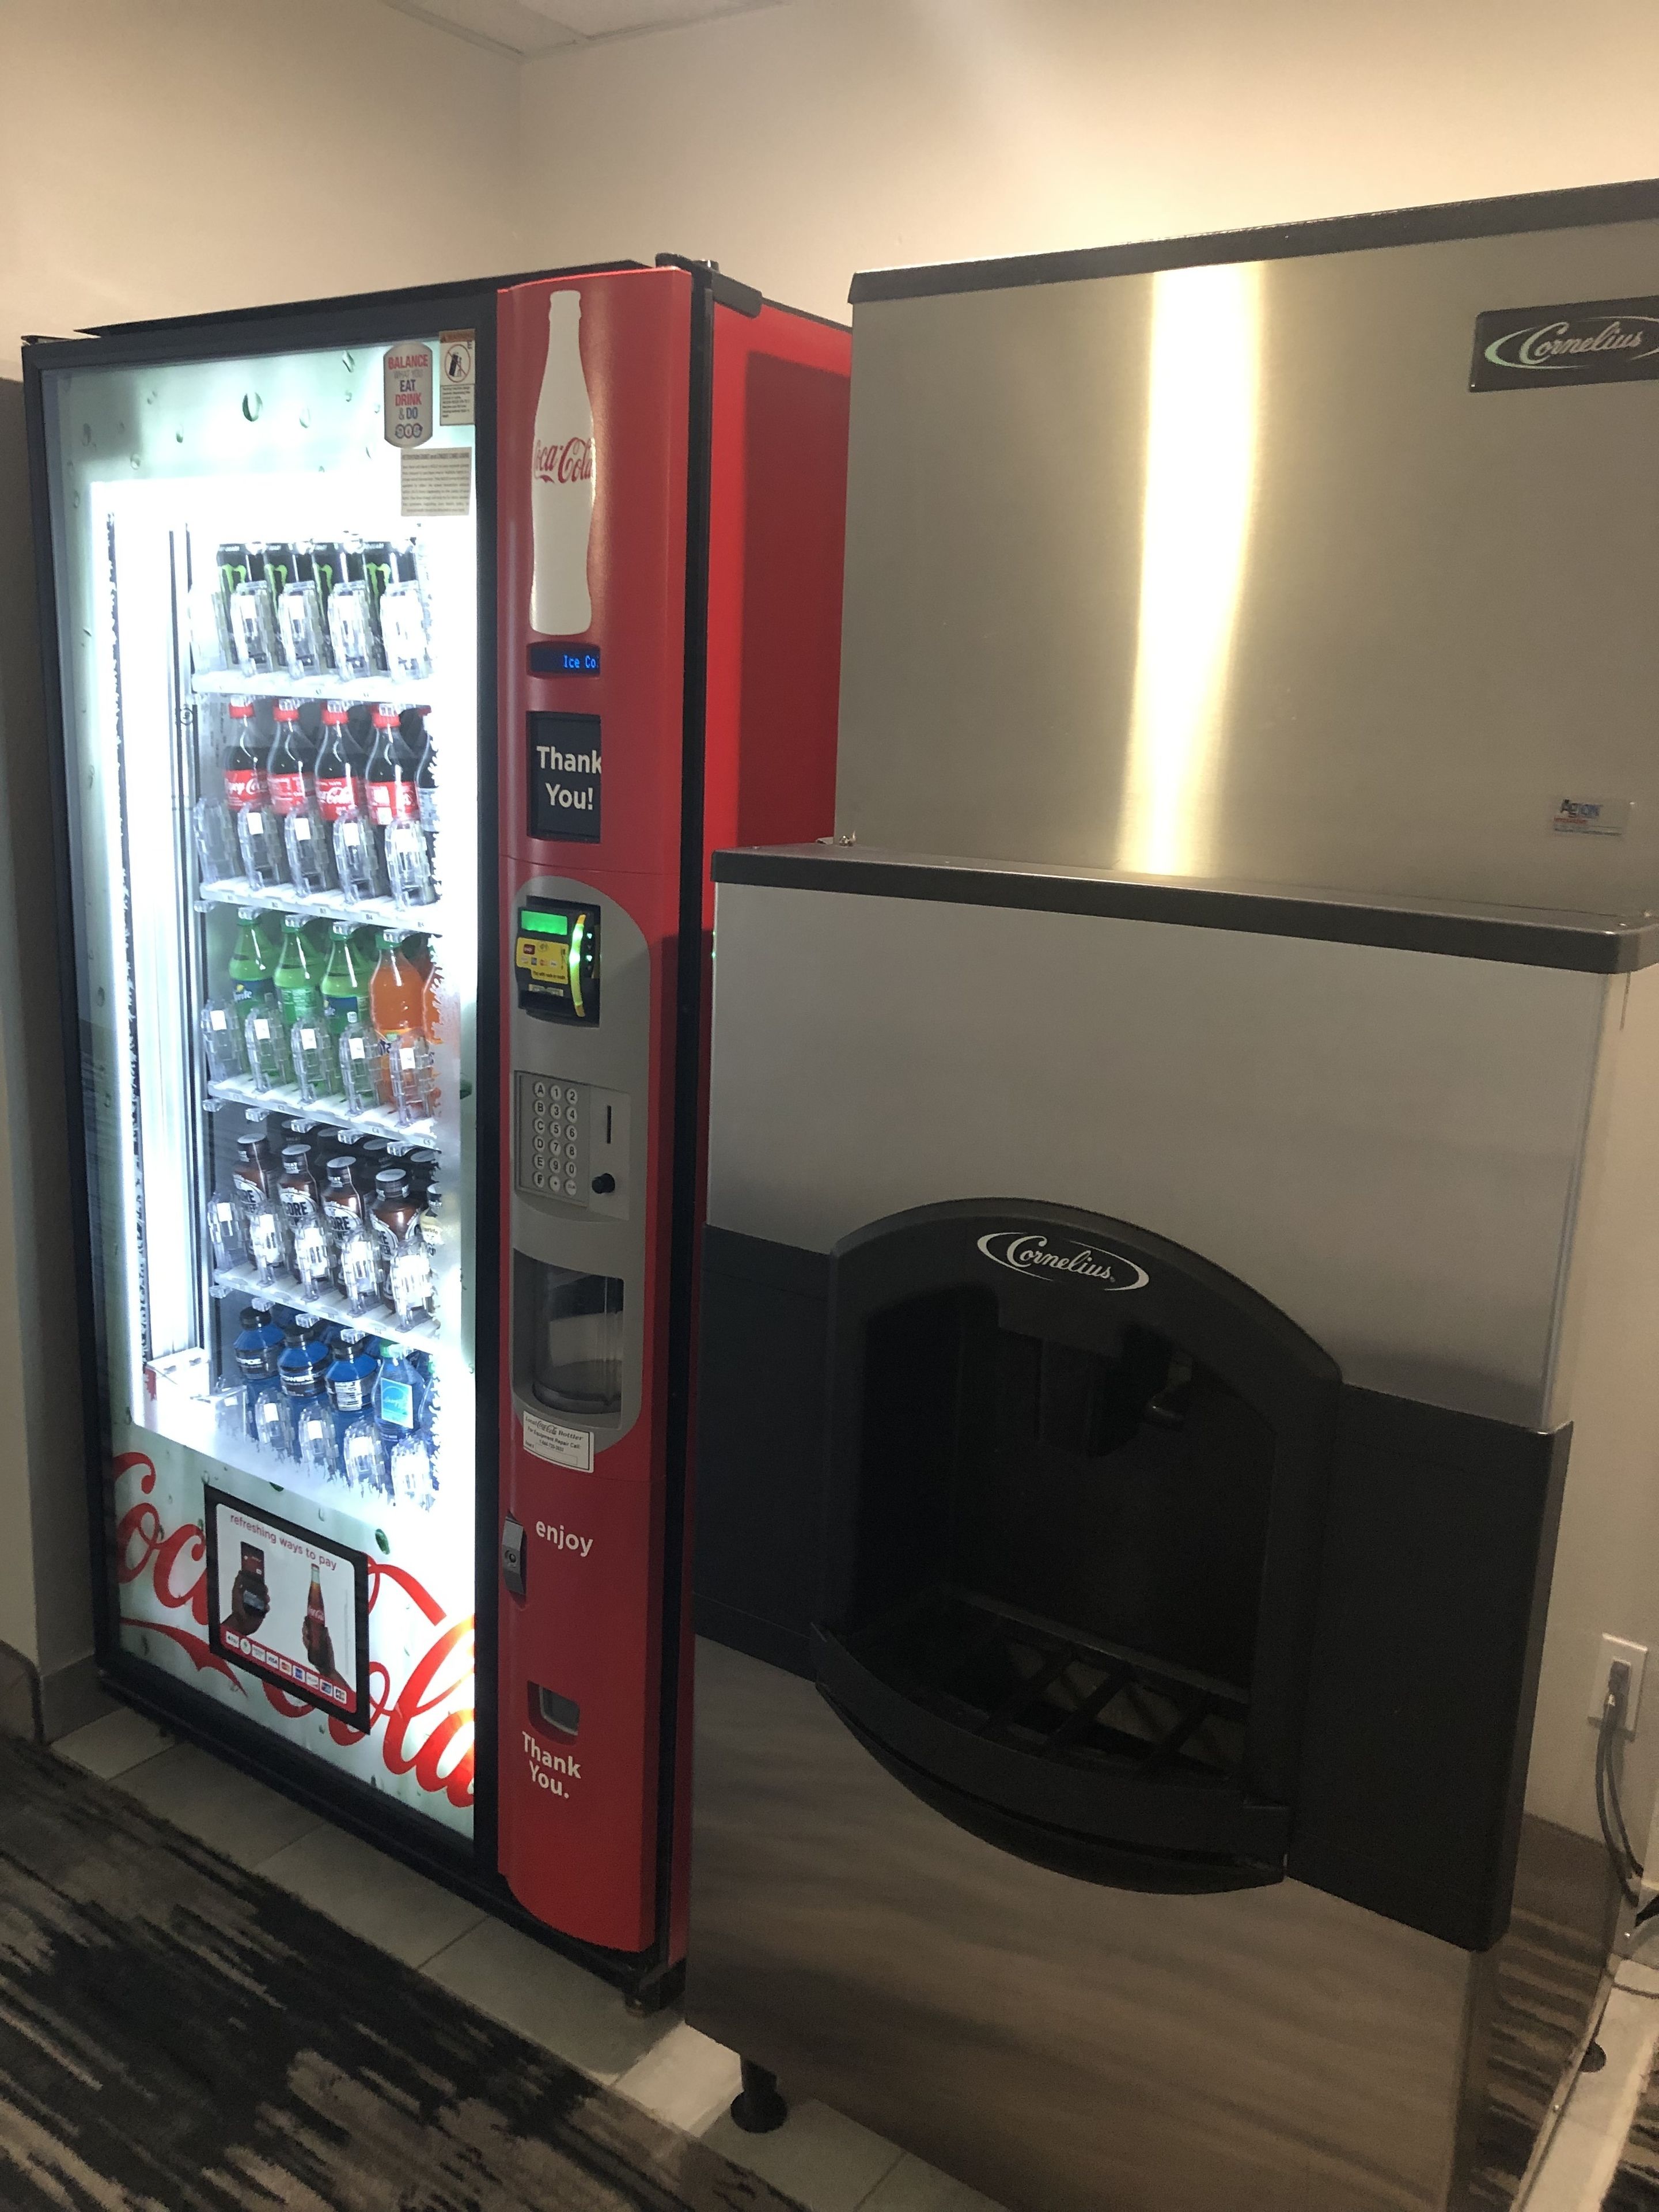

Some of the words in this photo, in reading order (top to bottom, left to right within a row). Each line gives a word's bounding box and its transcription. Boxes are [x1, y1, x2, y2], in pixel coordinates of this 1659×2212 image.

[1519, 320, 1643, 365] Cornelius
[388, 354, 428, 370] BALANCE
[400, 380, 415, 392] EAT
[395, 393, 422, 407] DRINK
[398, 408, 404, 420] &
[406, 407, 418, 419] DO
[563, 654, 580, 669] Ice
[536, 745, 601, 774] Thank
[545, 782, 594, 811] You!
[537, 1084, 544, 1093] A
[554, 1088, 558, 1097] 1
[570, 1091, 575, 1101] 2
[537, 1103, 543, 1112] B
[554, 1106, 559, 1116] 3
[570, 1109, 575, 1119] 4
[537, 1121, 544, 1130] C
[554, 1124, 559, 1134] 5
[570, 1128, 575, 1137] 6
[537, 1139, 543, 1148] D
[553, 1142, 559, 1152] 7
[570, 1146, 575, 1156] 8
[537, 1157, 543, 1166] E
[553, 1160, 558, 1170] 9
[569, 1164, 574, 1173] 0
[537, 1175, 543, 1184] F
[285, 1201, 308, 1215] ORE
[329, 1215, 350, 1230] ORE
[1006, 1235, 1112, 1280] Cornelius
[533, 1430, 554, 1442] Equipment
[555, 1438, 569, 1446] Repair
[558, 1430, 584, 1441] Bottler
[230, 1514, 276, 1544] refreshing
[279, 1537, 303, 1555] ways
[306, 1547, 316, 1560] to
[319, 1555, 337, 1571] pay
[536, 1520, 594, 1557] enjoy
[521, 1730, 581, 1779] Thank
[529, 1760, 570, 1799] You.
